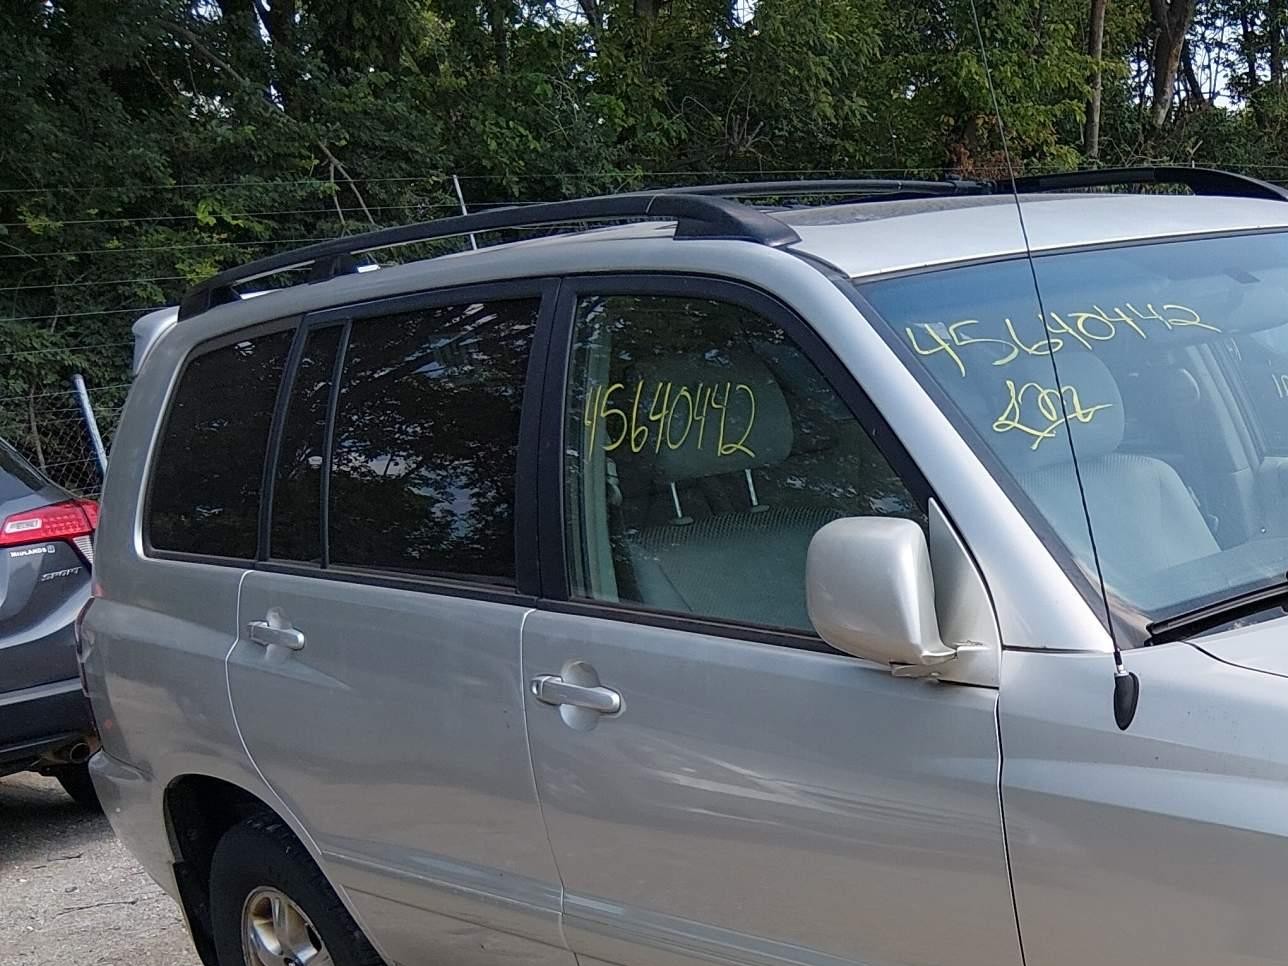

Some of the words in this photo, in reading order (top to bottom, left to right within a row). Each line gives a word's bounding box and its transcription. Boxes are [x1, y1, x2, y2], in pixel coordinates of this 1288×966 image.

[905, 303, 1222, 377] 45640442
[584, 380, 756, 459] 45640442
[41, 567, 82, 582] SPORT
